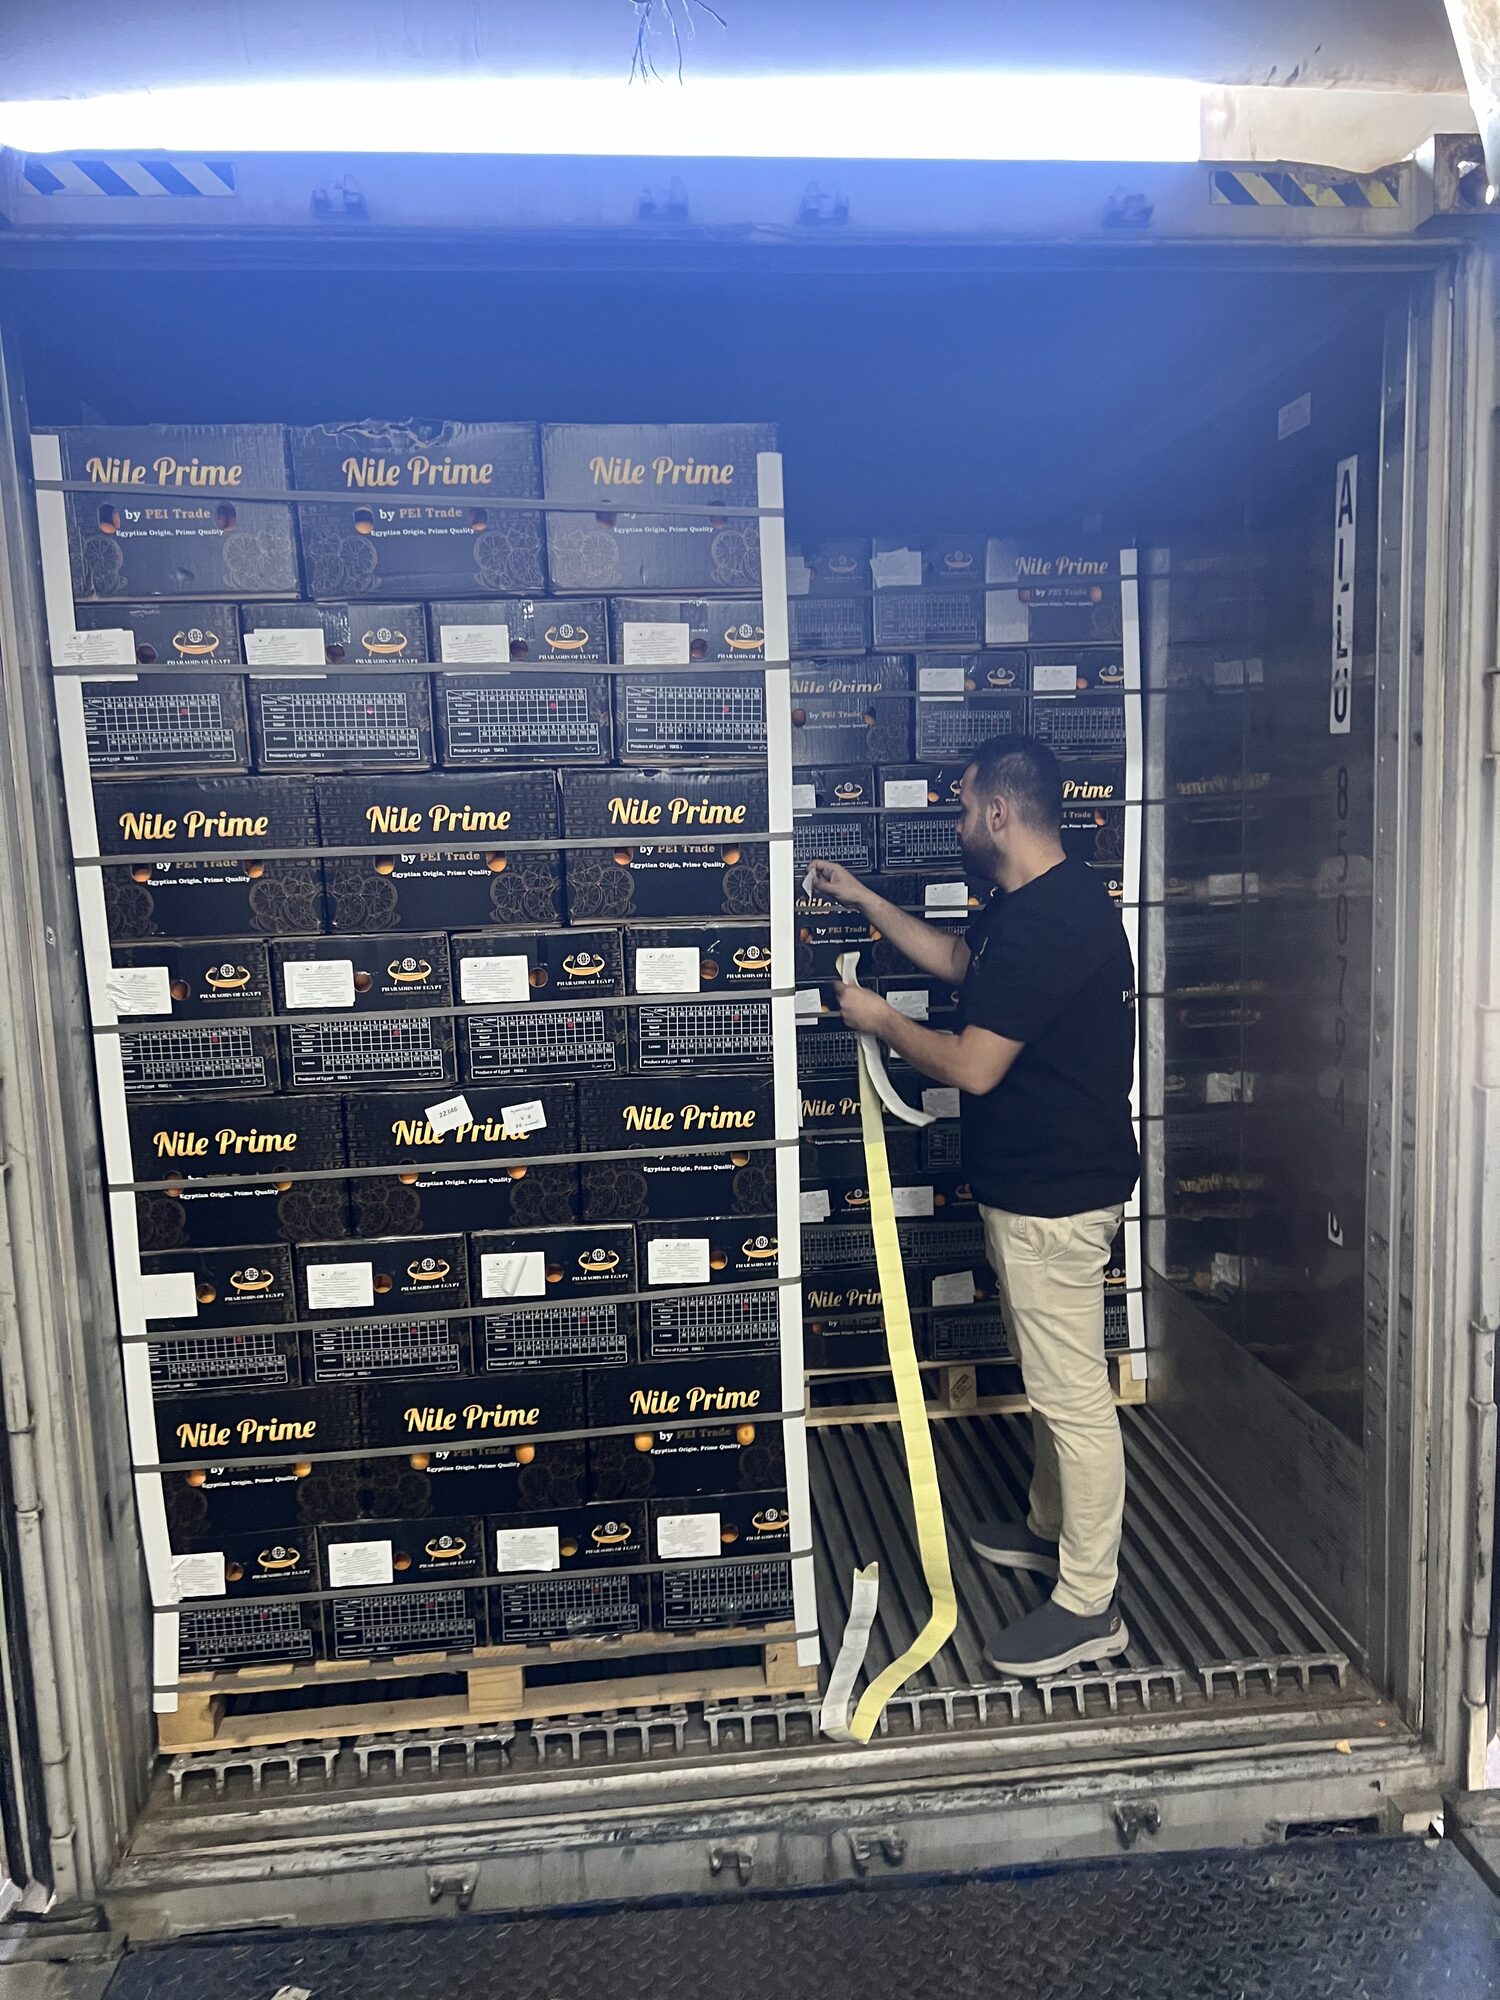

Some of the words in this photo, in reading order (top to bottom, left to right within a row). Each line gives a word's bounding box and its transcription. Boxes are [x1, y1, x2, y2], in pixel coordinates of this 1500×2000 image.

[86, 456, 147, 485] Nile
[153, 456, 242, 486] Prime
[342, 457, 400, 488] Nile
[407, 456, 493, 486] Prime
[589, 456, 645, 485] Nile
[652, 456, 734, 485] Prime
[124, 509, 141, 522] by
[145, 509, 169, 519] PEI
[172, 508, 211, 519] Trade
[379, 509, 395, 521] by
[400, 508, 421, 518] PEI
[425, 507, 462, 518] Trade
[115, 529, 148, 538] Egyptian
[198, 528, 224, 537] Quality
[370, 529, 401, 537] Egyptian
[428, 527, 448, 535] Prime
[449, 527, 475, 535] Quality
[613, 526, 643, 534] Egyptian
[669, 525, 688, 533] Prime
[689, 525, 714, 534] Quality
[1015, 556, 1051, 576] Nile
[1055, 556, 1109, 576] Prime
[1035, 589, 1046, 597] by
[829, 678, 882, 693] Prime
[809, 712, 819, 720] by
[1062, 780, 1114, 799] Prime
[608, 797, 662, 825] Nile
[667, 797, 747, 825] Prime
[1069, 811, 1092, 819] Trade
[118, 811, 177, 840] Nile
[183, 810, 269, 838] Prime
[366, 805, 422, 833] Nile
[428, 804, 511, 832] Prime
[639, 845, 654, 856] by
[657, 845, 678, 853] PEI
[681, 844, 715, 853] Trade
[202, 860, 238, 868] Trade
[401, 853, 416, 864] by
[420, 852, 441, 862] PEI
[445, 852, 480, 861] Trade
[702, 861, 725, 869] Quality
[467, 869, 492, 877] Quality
[147, 878, 177, 886] Egyptian
[225, 876, 250, 884] Quality
[816, 927, 826, 935] by
[801, 1099, 836, 1117] Nile
[622, 1105, 674, 1131] Nile
[680, 1104, 756, 1130] Prime
[153, 1130, 209, 1158] Nile
[214, 1128, 298, 1155] Prime
[488, 1177, 513, 1185] Quality
[807, 1290, 842, 1309] Nile
[828, 1320, 837, 1328] by
[629, 1390, 681, 1415] Nile
[686, 1386, 761, 1412] Prime
[404, 1406, 457, 1433] Nile
[462, 1403, 540, 1430] Prime
[176, 1422, 231, 1449] Nile
[236, 1417, 317, 1444] Prime
[659, 1431, 673, 1442] by
[677, 1430, 696, 1440] PEI
[699, 1427, 731, 1438] Trade
[435, 1451, 450, 1460] by
[650, 1447, 678, 1455] Egyptian
[426, 1465, 454, 1473] Egyptian
[497, 1461, 520, 1469] Quality
